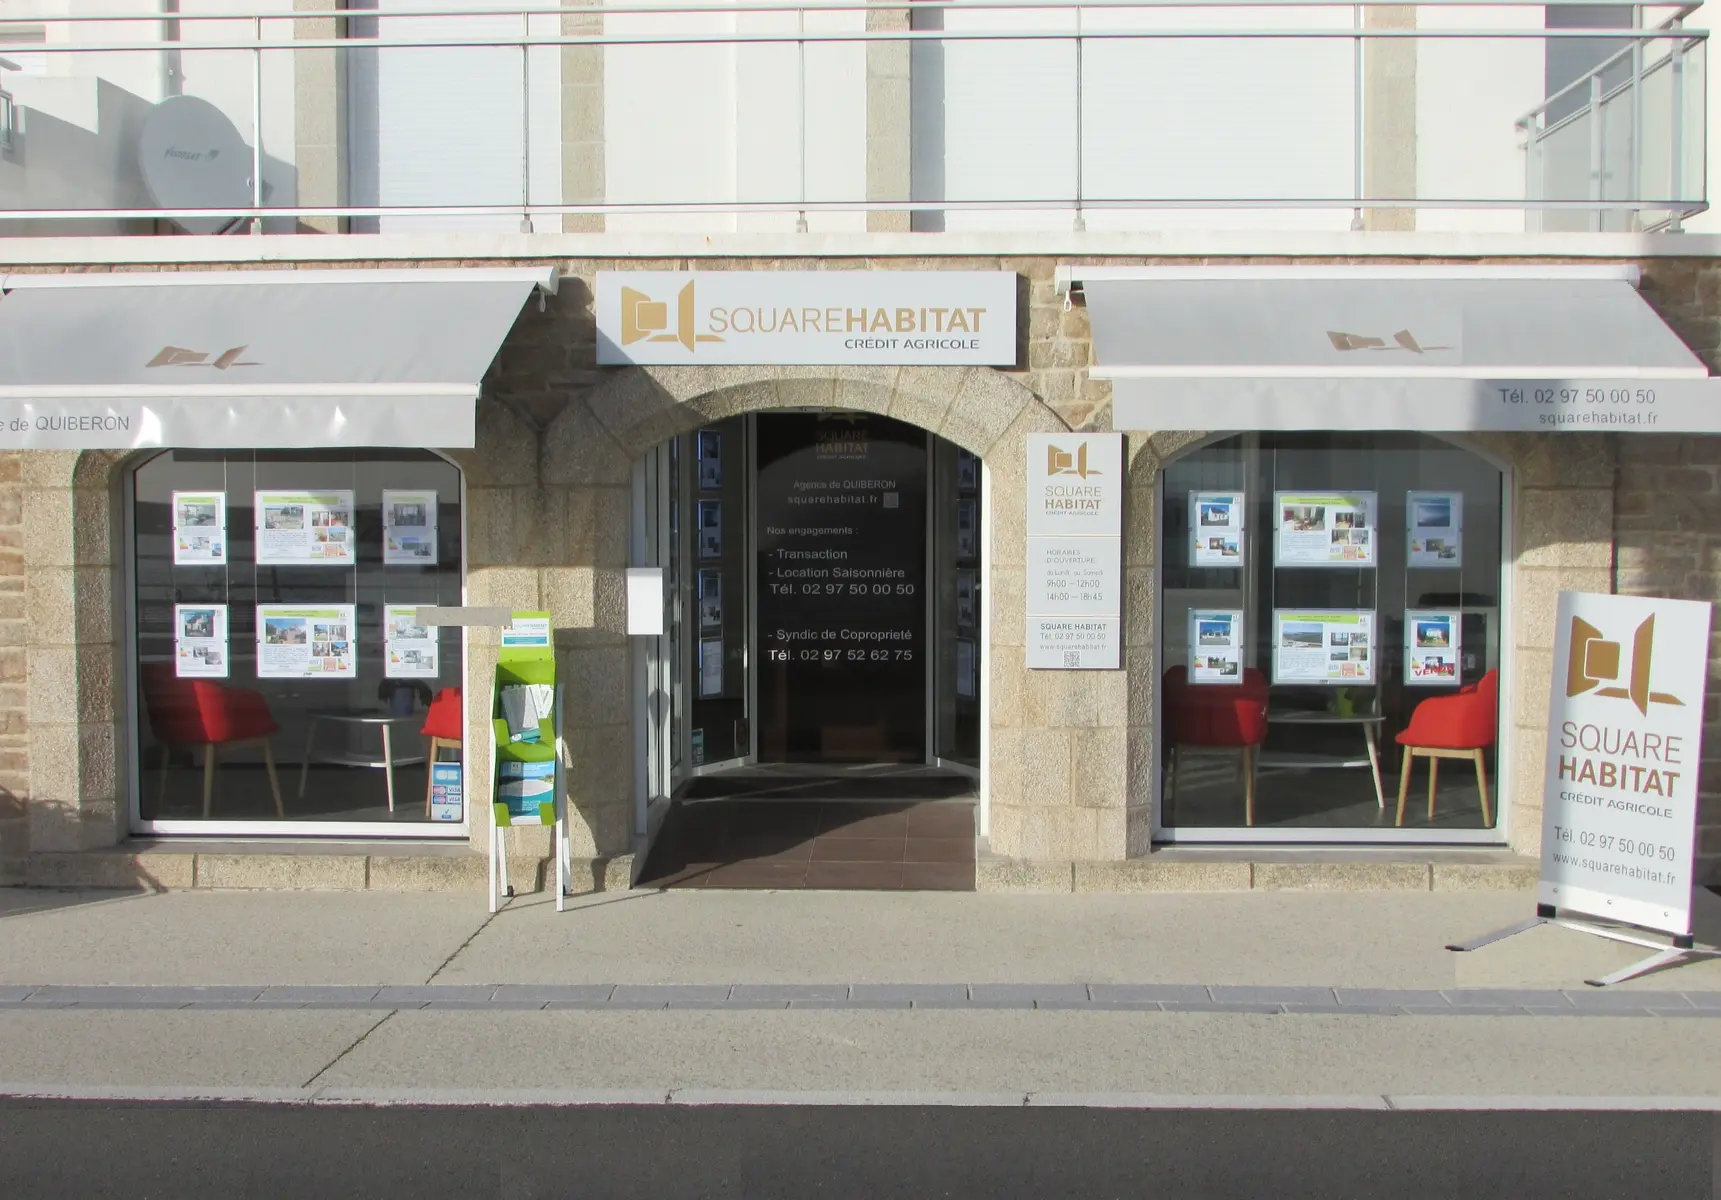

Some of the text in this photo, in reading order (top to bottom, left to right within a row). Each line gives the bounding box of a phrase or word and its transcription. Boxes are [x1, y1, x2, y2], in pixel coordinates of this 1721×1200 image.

[708, 306, 987, 334] SQUAREHABITAT
[844, 336, 980, 350] CRÉDIT AGRICOLE
[1498, 388, 1655, 404] Tél. 02 97 50 00 50
[10, 417, 29, 432] de
[35, 416, 130, 431] QUIBERON
[1539, 411, 1658, 426] squarehabitat.fr
[815, 442, 869, 453] HABITAT
[793, 480, 896, 491] Agence de QUIBERON
[1045, 486, 1102, 497] SQUARE
[787, 495, 878, 506] squarehabitat.fr
[1045, 499, 1101, 510] HABITAT
[767, 526, 786, 535] Nos
[788, 526, 853, 537] engagements
[777, 549, 848, 559] Transaction
[777, 567, 829, 578] Location
[832, 567, 905, 578] Saisonnière
[769, 583, 915, 595] Tél. 02 97 50 00 50
[1046, 579, 1067, 588] 9h00
[1077, 579, 1100, 588] 12h00
[1046, 592, 1070, 601] 14h00
[1080, 592, 1103, 601] 18h45
[776, 629, 818, 641] Syndic
[821, 629, 836, 640] de
[768, 649, 913, 661] Tél. 02 97 52 62 75
[1560, 721, 1683, 764] SQUARE
[1558, 754, 1681, 798] HABITAT
[1560, 791, 1673, 818] CRÉDIT AGRICOLE
[1554, 825, 1675, 862] Tél. 02 97 50 00 50
[1552, 852, 1676, 885] www.squarehabitat.fr
